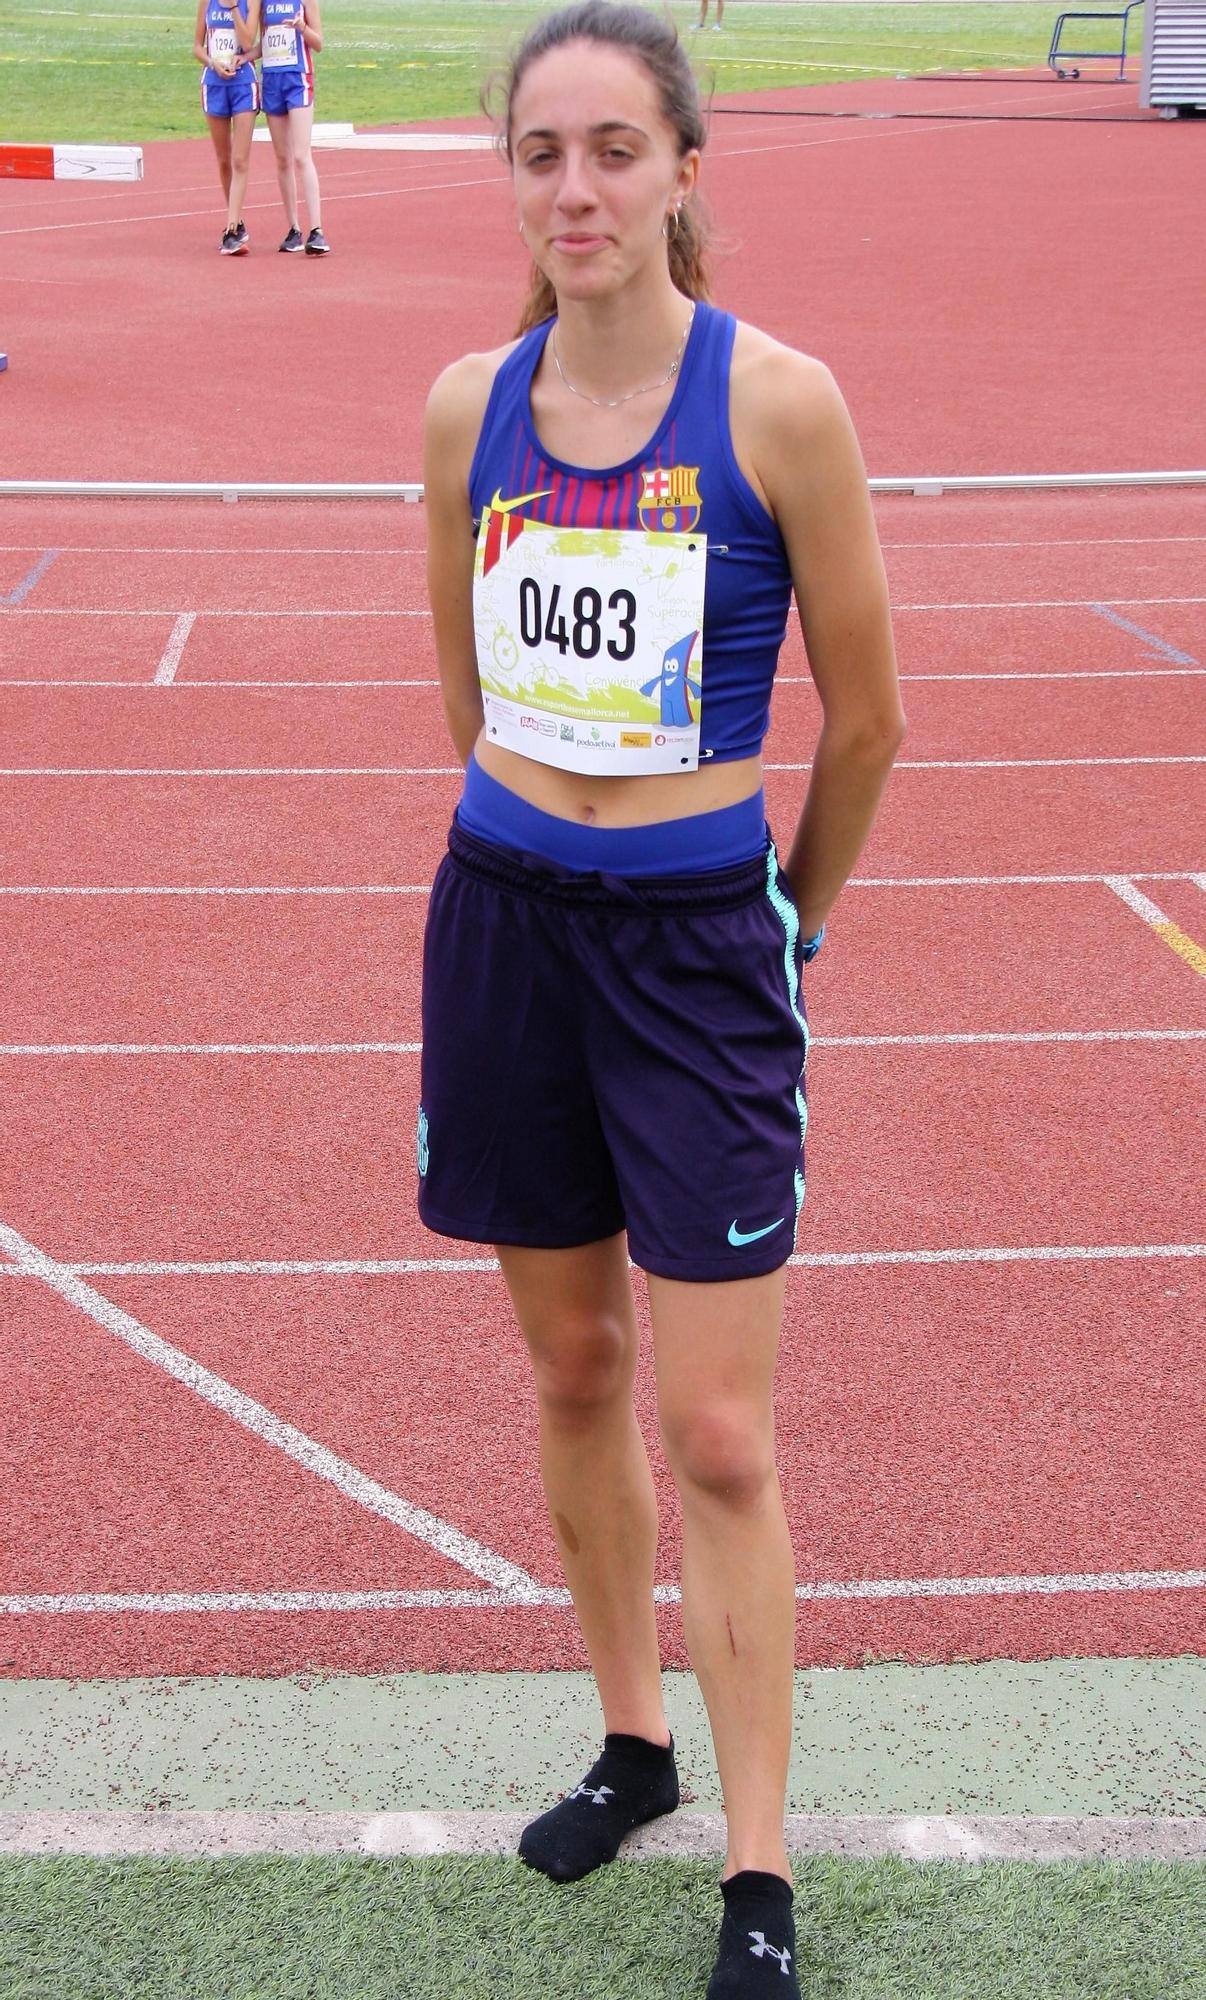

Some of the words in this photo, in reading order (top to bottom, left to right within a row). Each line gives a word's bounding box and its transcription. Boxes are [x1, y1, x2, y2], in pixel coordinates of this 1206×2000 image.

[215, 38, 234, 51] 1294
[268, 34, 287, 48] 0274
[656, 497, 681, 506] FCB
[519, 576, 637, 662] 0483
